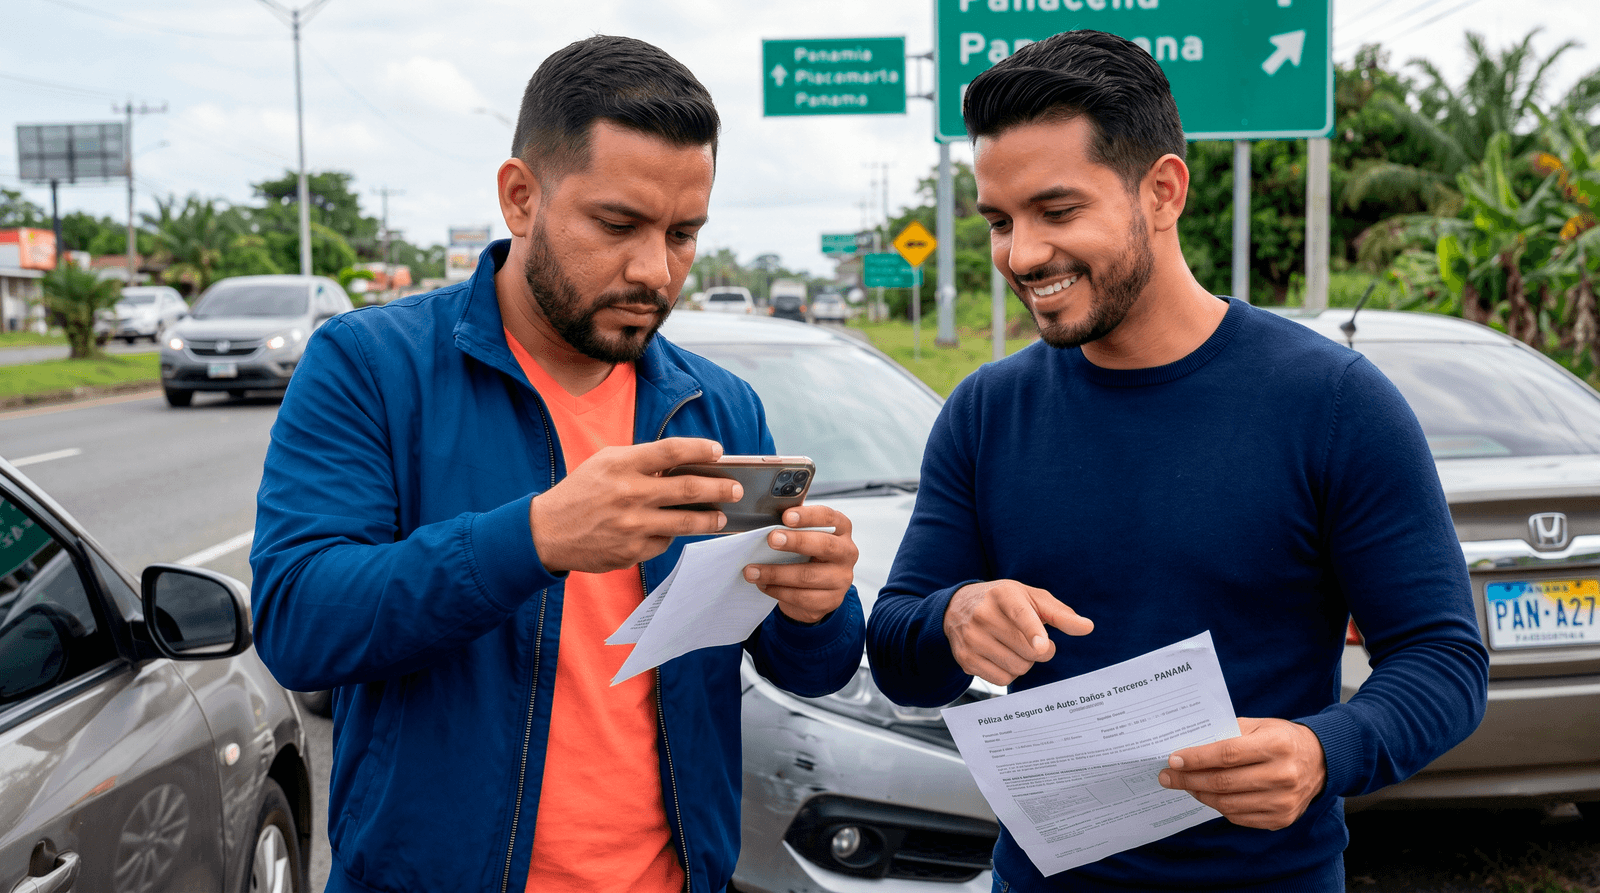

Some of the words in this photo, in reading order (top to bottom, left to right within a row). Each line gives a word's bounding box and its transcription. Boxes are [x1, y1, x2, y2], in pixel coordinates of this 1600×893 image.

[795, 91, 868, 108] Panama
[977, 715, 1003, 726] Póliza
[1003, 713, 1014, 721] de
[1014, 707, 1043, 719] Seguro
[1044, 704, 1055, 712] de
[1056, 699, 1079, 710] Auto:
[1079, 692, 1105, 704] Daños
[1112, 679, 1149, 695] Terceros
[1154, 661, 1193, 682] PANAMÁ
